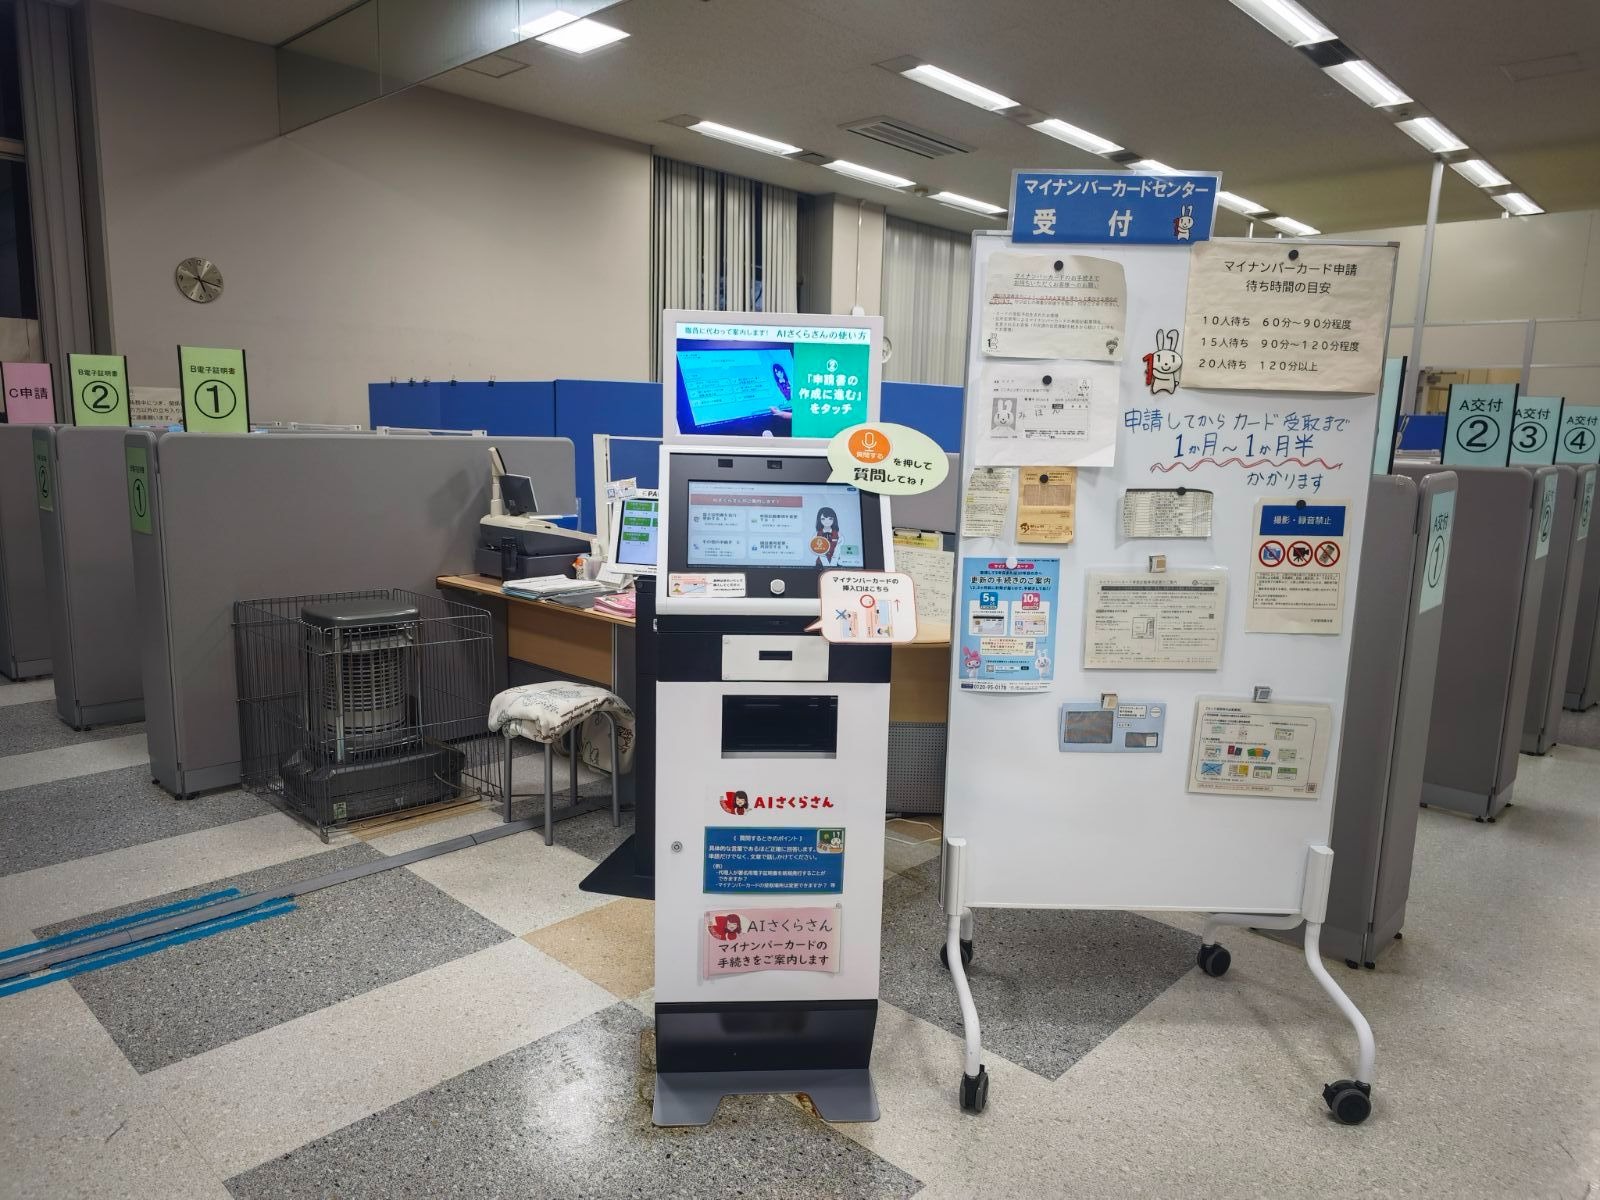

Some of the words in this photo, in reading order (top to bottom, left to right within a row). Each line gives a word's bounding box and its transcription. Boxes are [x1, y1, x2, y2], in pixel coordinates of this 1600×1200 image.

[1024, 179, 1209, 198] マイナンバーカードセンター
[1033, 208, 1057, 236] 受
[1108, 209, 1133, 237] 付
[1224, 260, 1358, 277] マイナンバーカード申請
[1245, 280, 1332, 294] 待ち時間の目安
[1203, 316, 1250, 327] 10人待ち
[1262, 317, 1352, 330] 60分～90分程度
[776, 328, 867, 341] AIさくらさんの使い方
[1201, 337, 1249, 348] 15人待ち
[1261, 339, 1360, 352] 90分～120分程度
[190, 365, 236, 375] B電子証明書
[1198, 358, 1247, 370] 20人待ち
[1260, 361, 1319, 372] 120分以上
[78, 368, 118, 378] B電子証明書
[807, 374, 859, 387] 「申請書の
[9, 387, 49, 400] C申請
[798, 388, 863, 402] 作成に進む」
[809, 403, 853, 416] をタッチ
[1459, 398, 1503, 412] A交付
[1515, 408, 1551, 420] A交付
[1566, 415, 1599, 426] A交付
[893, 457, 933, 471] を押して
[853, 467, 925, 486] 質問してね!
[1247, 470, 1324, 494] かかります
[833, 576, 899, 585] マイナンバーカードの
[971, 576, 1051, 585] 更新の手続きのご案内
[754, 796, 834, 809] AIさくらさん
[747, 918, 833, 933] AIさくらさん
[718, 940, 828, 953] マイナンバーカードの
[717, 954, 829, 969] 手続きをご案内します
